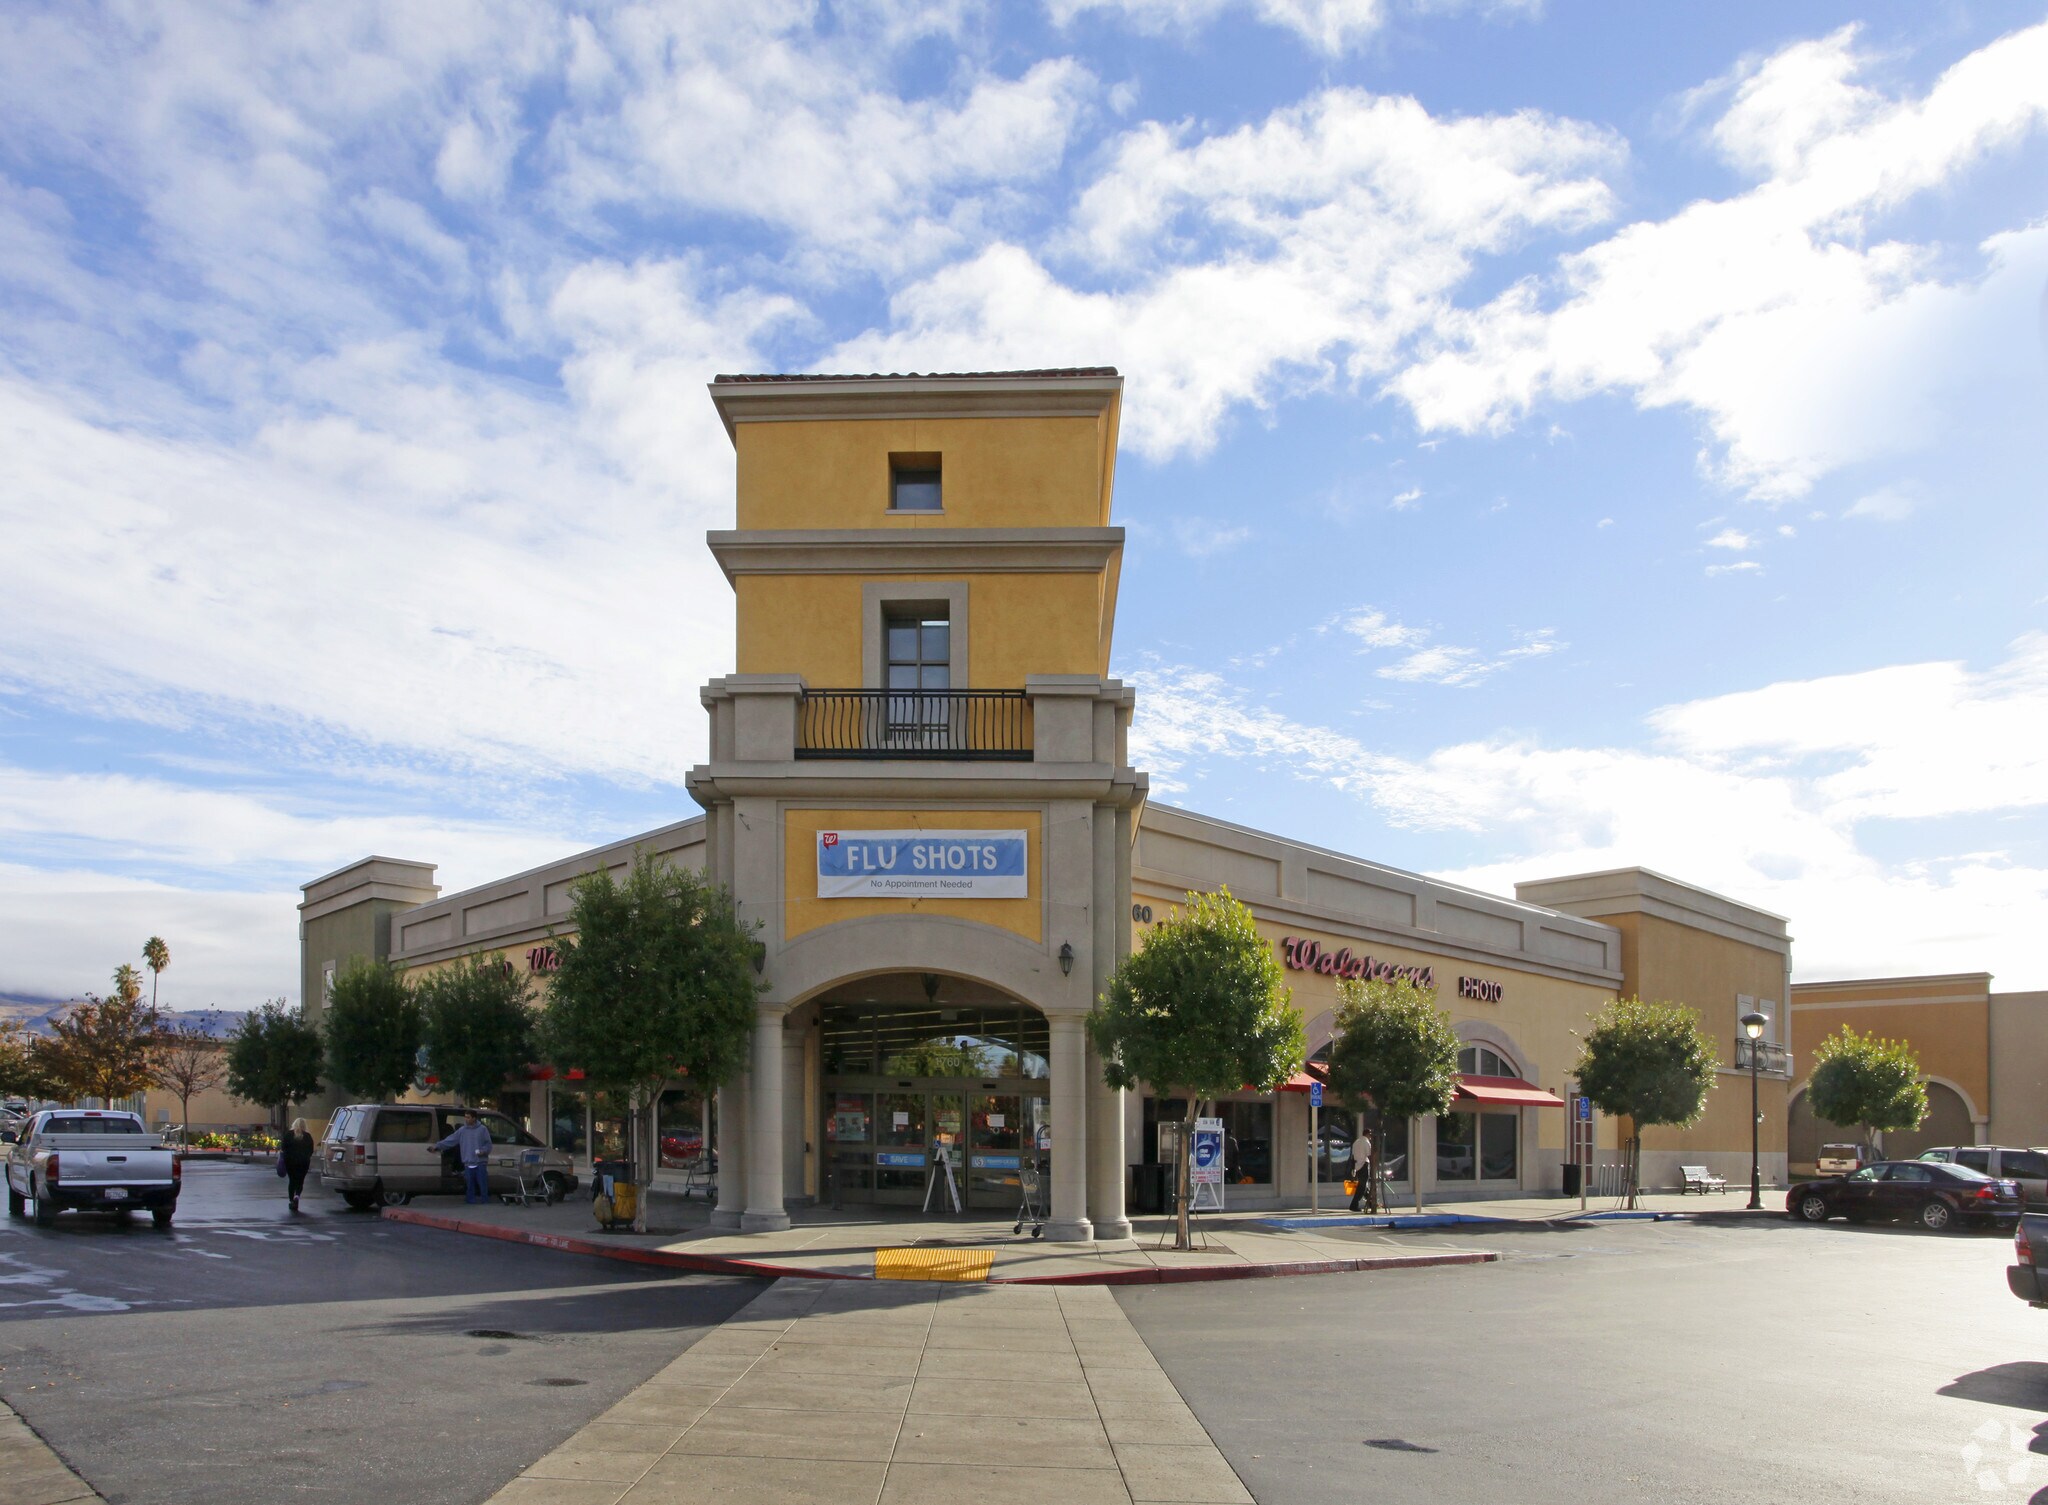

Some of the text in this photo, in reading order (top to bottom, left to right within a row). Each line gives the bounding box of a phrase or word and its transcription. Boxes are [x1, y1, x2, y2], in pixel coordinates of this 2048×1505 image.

[824, 834, 837, 844] W
[847, 846, 998, 870] FLU SHOTS
[870, 880, 973, 889] No Appointment Needed
[1284, 936, 1435, 989] Walgreens
[1461, 976, 1504, 1003] PHOTO
